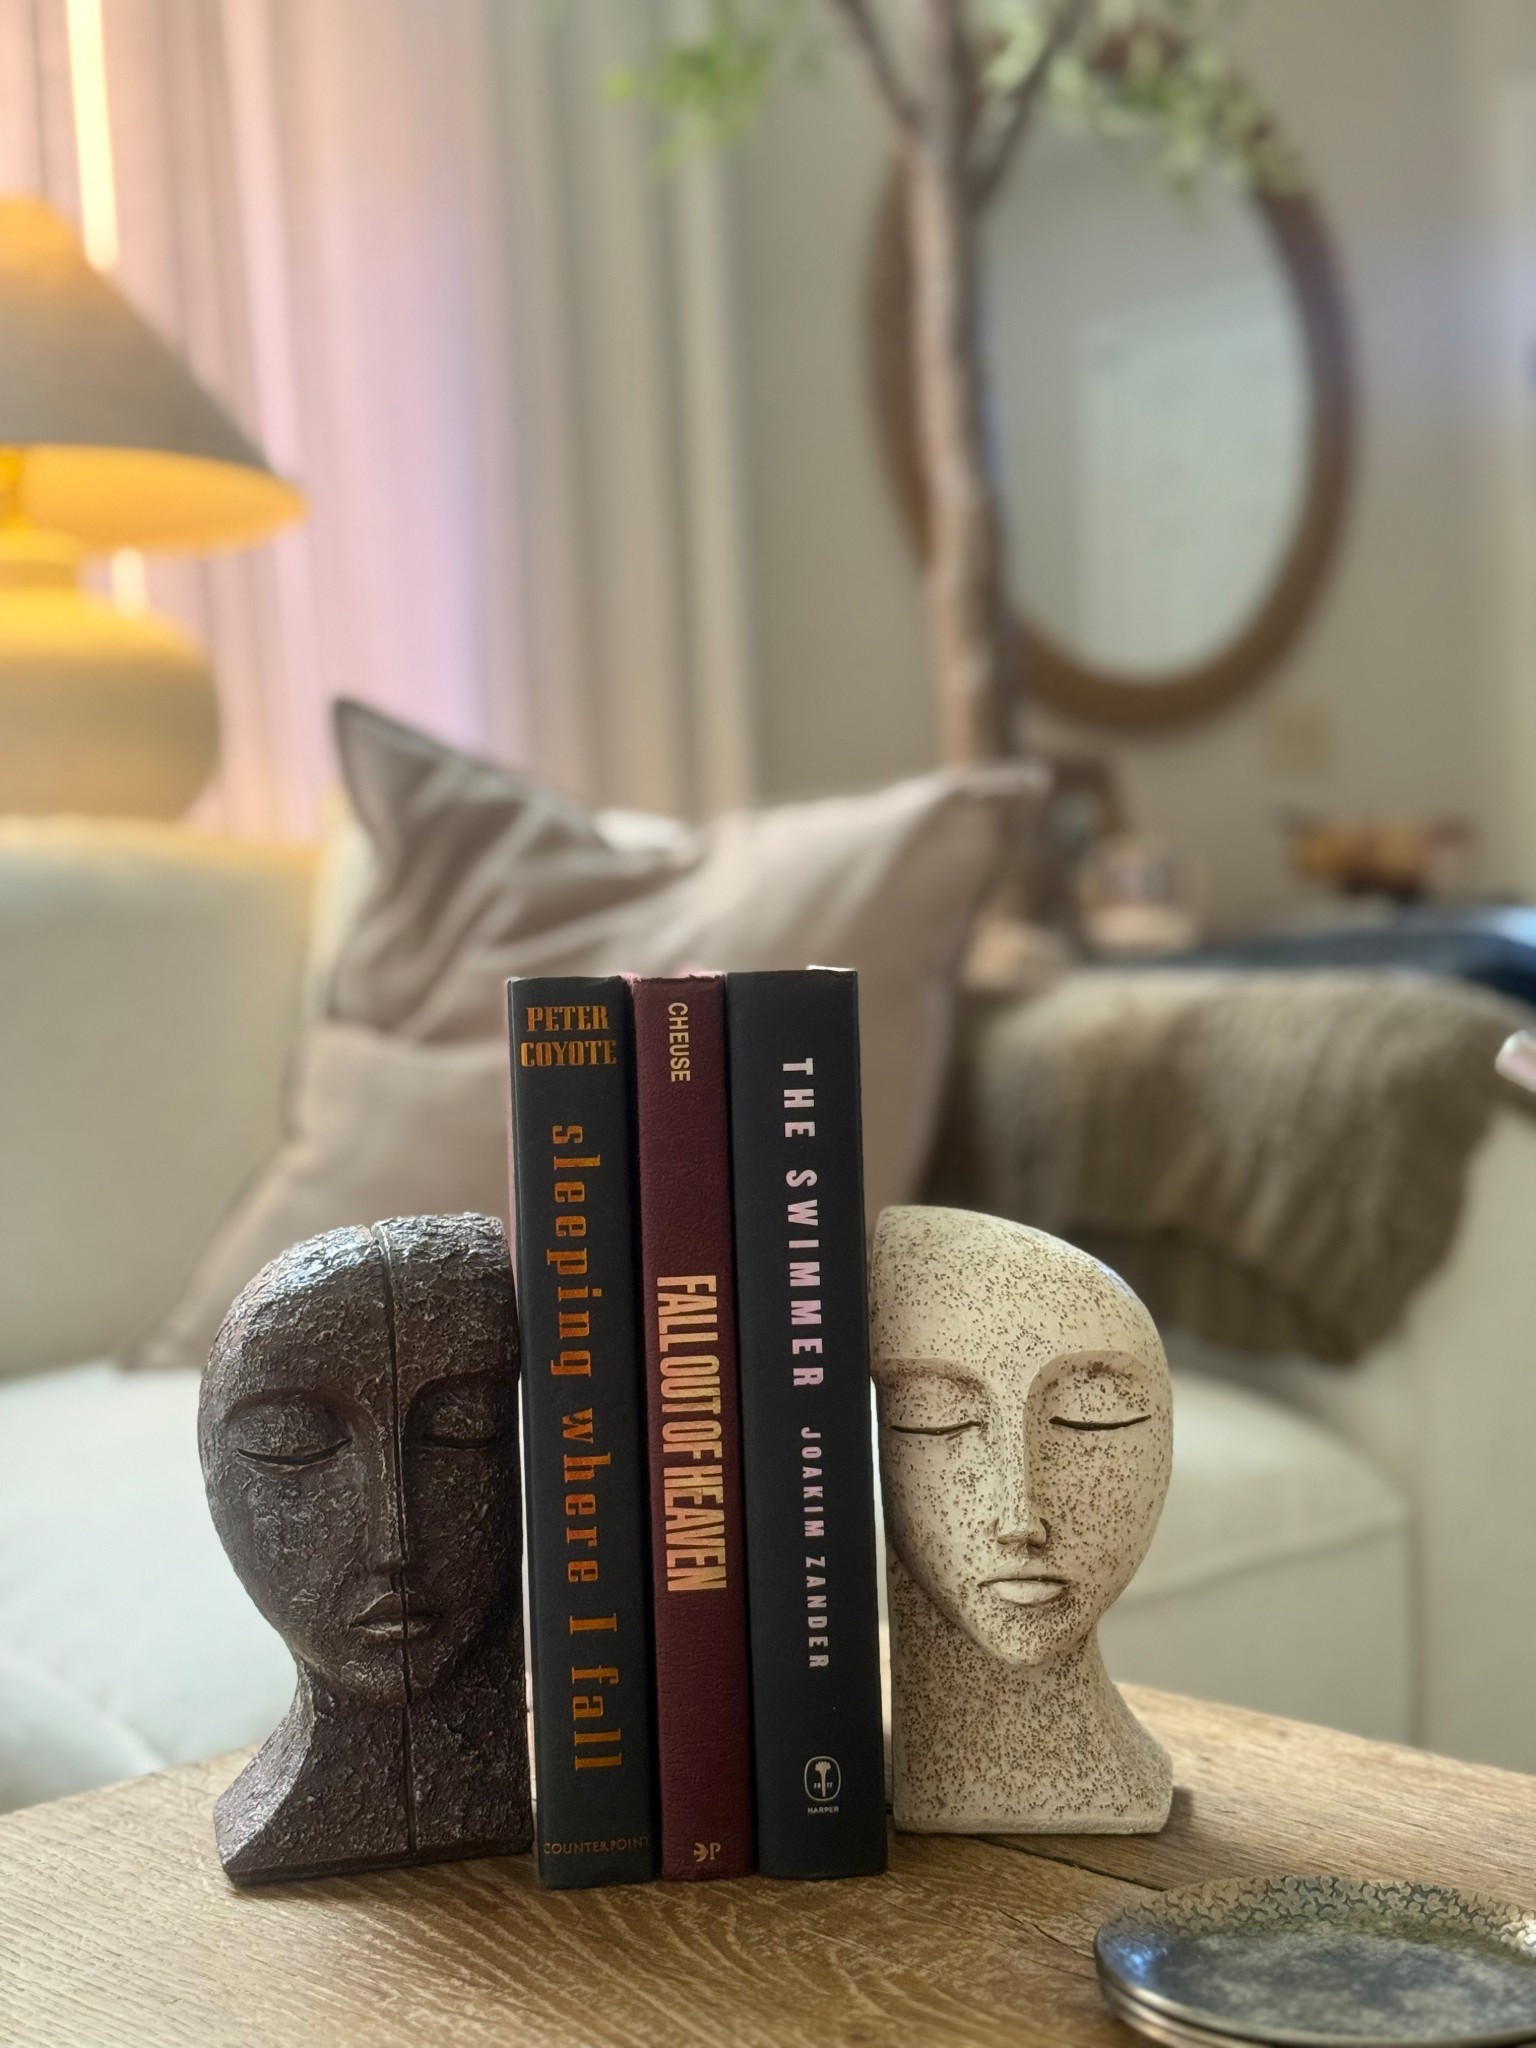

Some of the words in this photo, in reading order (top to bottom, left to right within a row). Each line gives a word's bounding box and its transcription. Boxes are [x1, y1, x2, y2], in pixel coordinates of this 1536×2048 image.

[520, 1039, 617, 1067] COYOTE
[526, 1005, 610, 1032] PETER
[667, 1002, 691, 1082] CHEUSE
[782, 1057, 816, 1138] THE
[546, 1124, 603, 1378] sleeping
[785, 1169, 824, 1386] SWIMMER
[656, 1274, 719, 1352] FALL
[659, 1354, 722, 1415] OUT
[661, 1420, 723, 1460] OF
[561, 1407, 612, 1583] where
[800, 1426, 825, 1537] JOAKIM
[663, 1464, 727, 1592] HEAVEN
[805, 1556, 830, 1668] ZANDER
[571, 1665, 622, 1771] fall
[543, 1836, 649, 1855] COUNTERPOINT
[807, 1805, 840, 1814] HARPER
